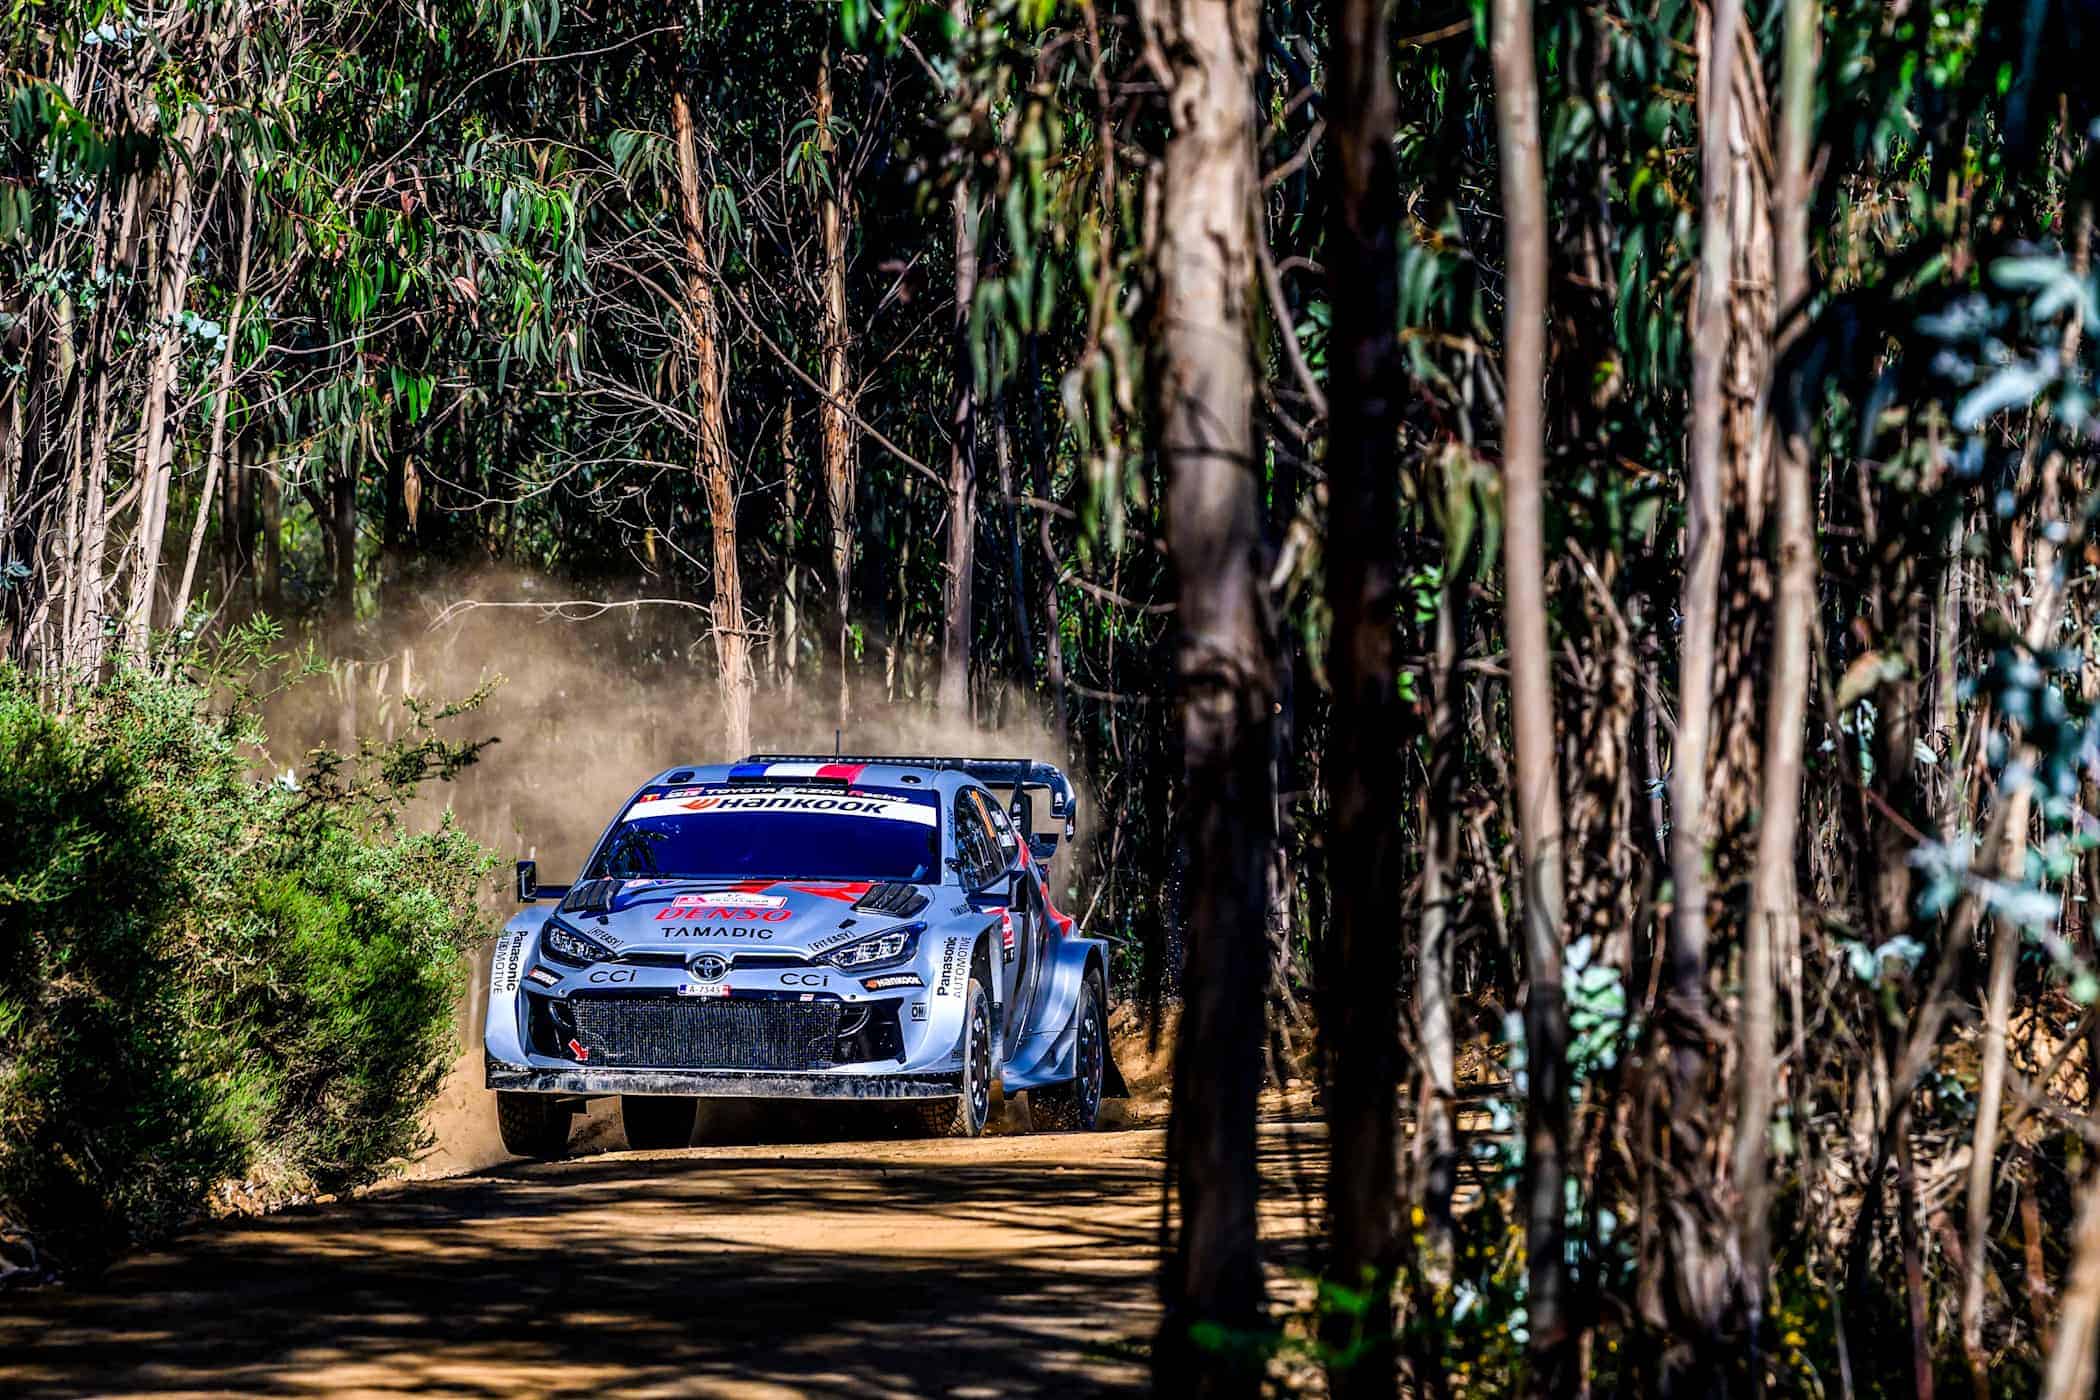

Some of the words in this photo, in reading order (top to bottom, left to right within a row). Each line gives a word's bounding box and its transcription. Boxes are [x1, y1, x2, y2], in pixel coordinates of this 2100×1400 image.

[705, 787, 777, 795] TOYOTA
[655, 907, 793, 923] DENSO
[660, 926, 774, 940] TAMADIC
[494, 932, 511, 995] UTOMOTIVE
[506, 930, 529, 992] Panasonic
[936, 935, 958, 997] Panasonic
[952, 935, 972, 999] AUTOMOTIVE
